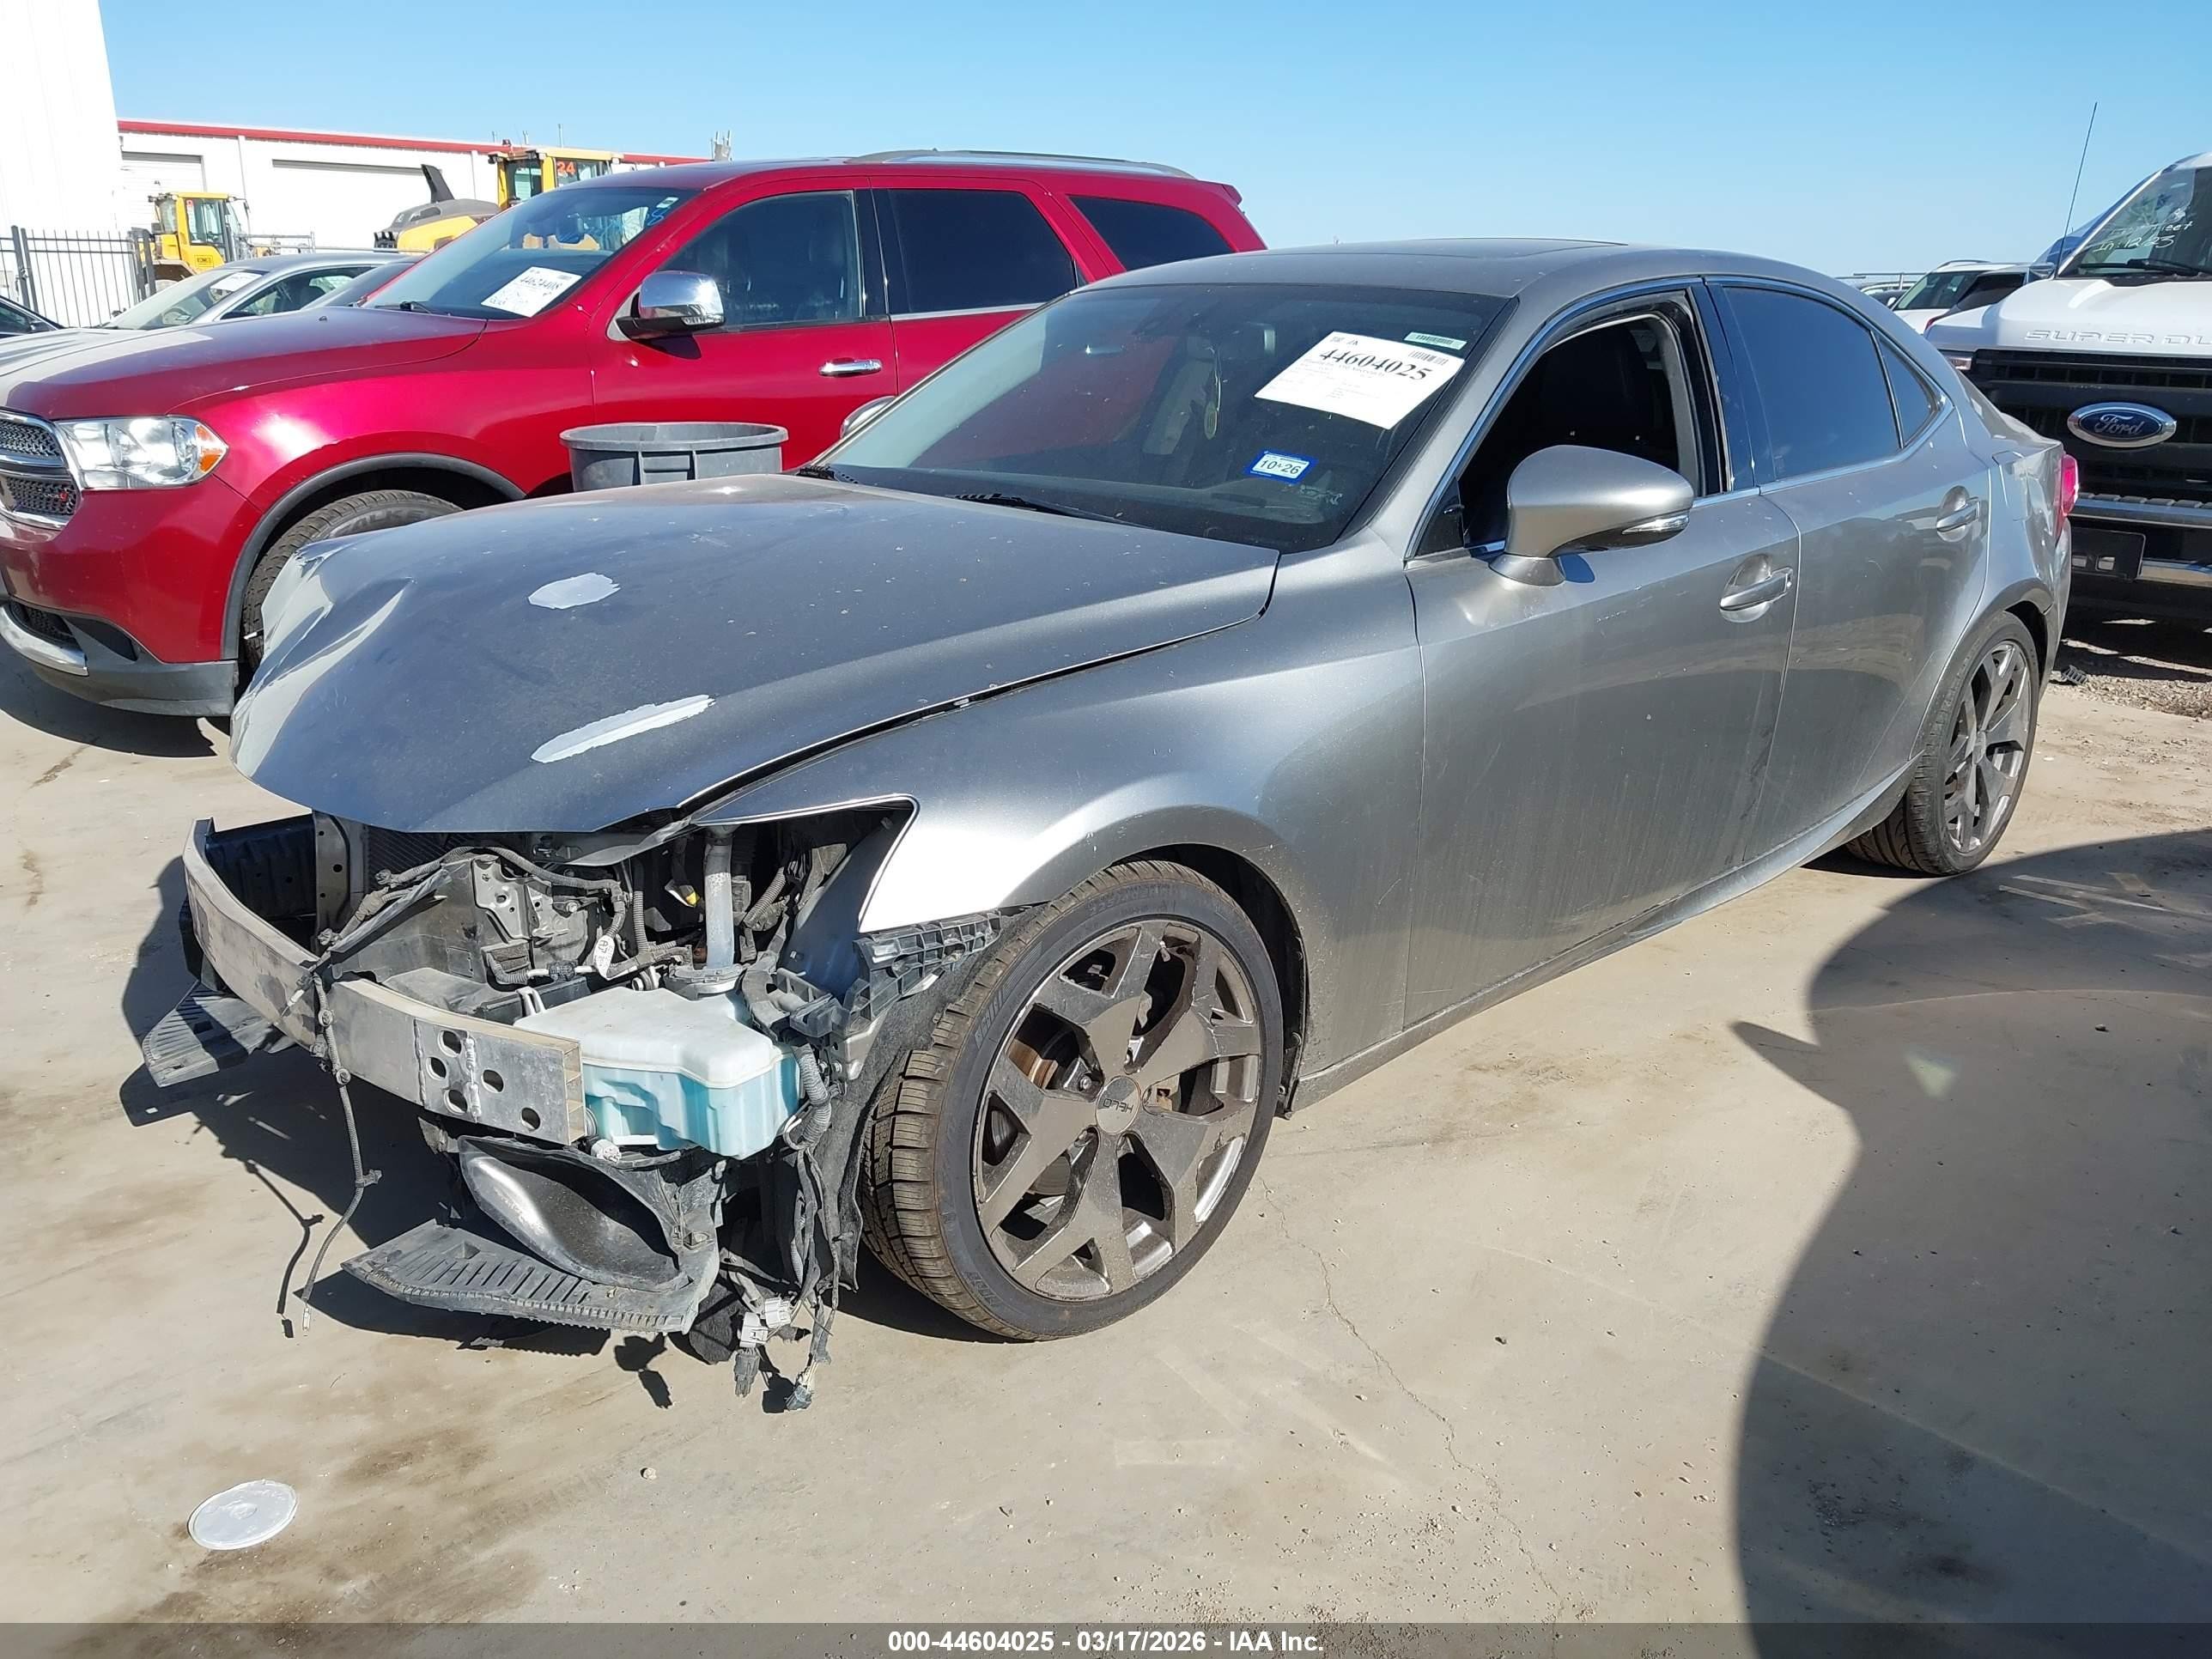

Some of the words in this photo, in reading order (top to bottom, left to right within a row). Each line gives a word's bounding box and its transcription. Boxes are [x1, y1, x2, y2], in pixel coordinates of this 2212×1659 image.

[556, 160, 576, 175] 24
[2025, 330, 2154, 343] SUPER
[1320, 349, 1433, 380] 44604025
[2094, 413, 2146, 434] Ford
[1281, 464, 1302, 474] 26
[1103, 1098, 1134, 1113] HELO
